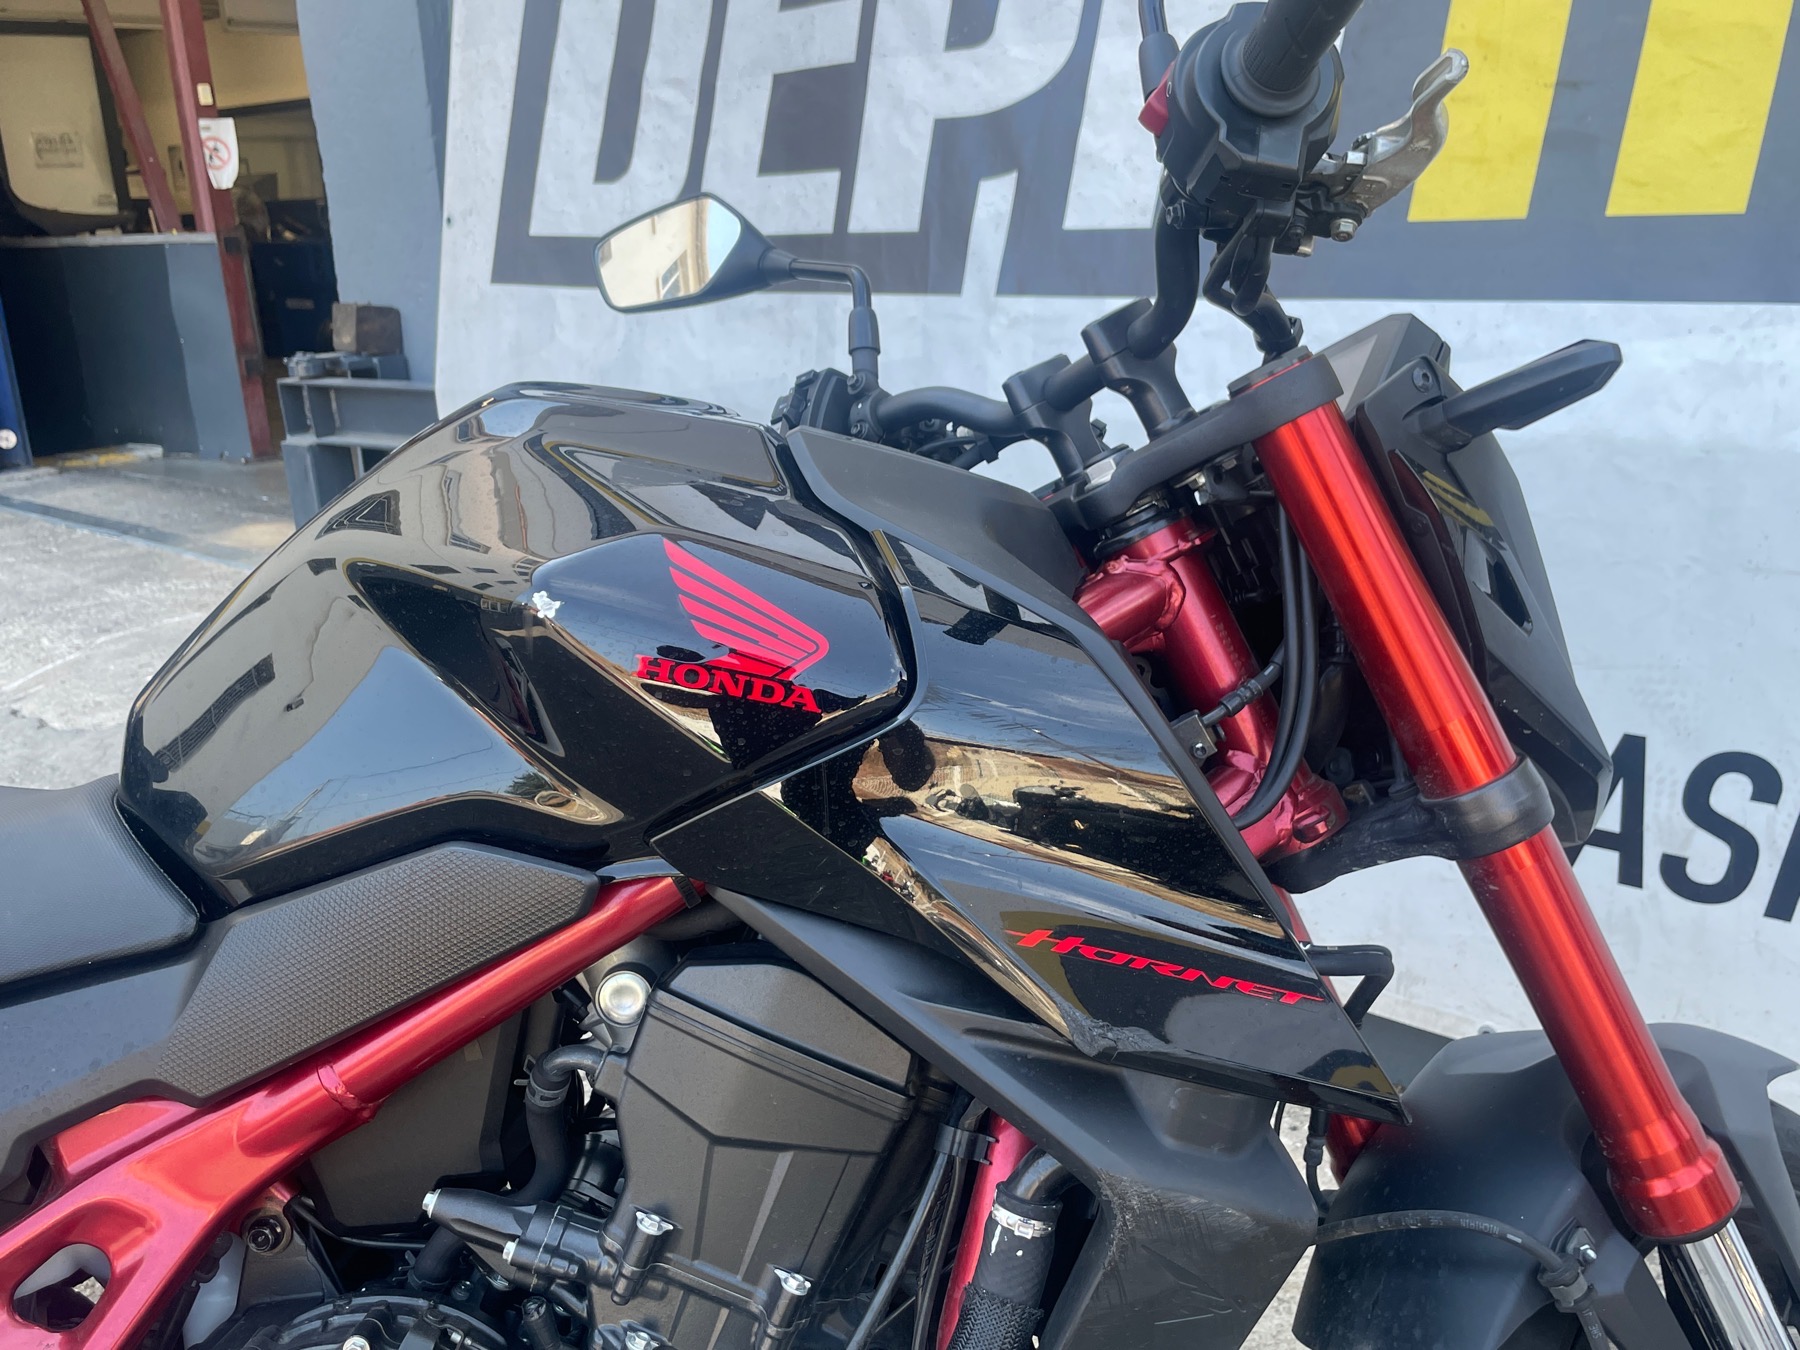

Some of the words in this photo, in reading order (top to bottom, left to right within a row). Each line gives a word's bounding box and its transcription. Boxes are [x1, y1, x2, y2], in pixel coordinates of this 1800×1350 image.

[631, 653, 822, 715] HONDA
[1004, 928, 1325, 1005] HORNET
[1460, 1218, 1500, 1235] NICHIRIN
